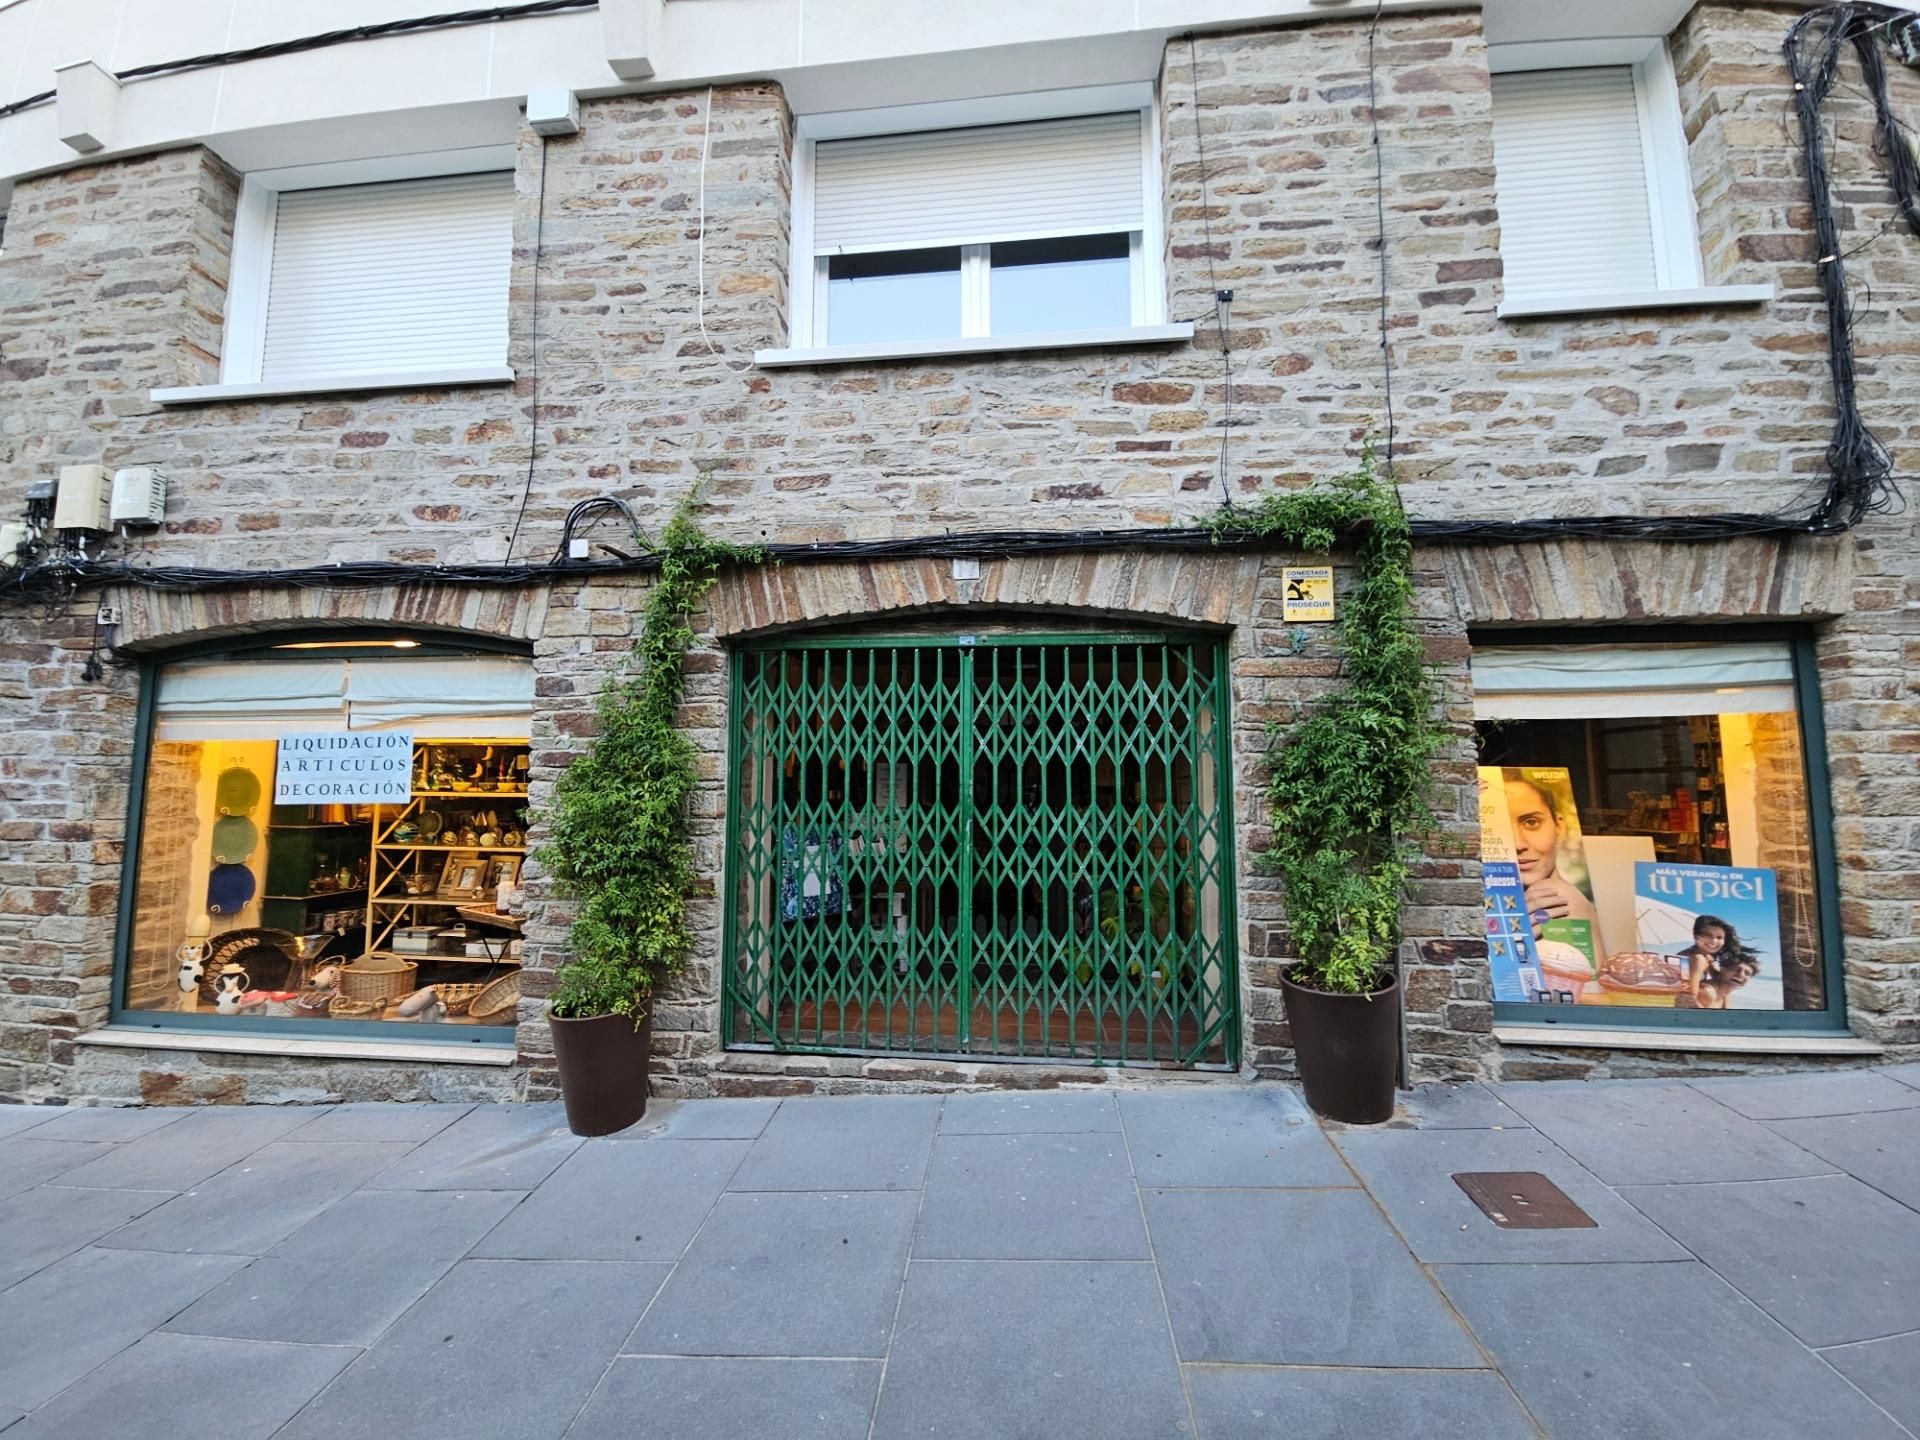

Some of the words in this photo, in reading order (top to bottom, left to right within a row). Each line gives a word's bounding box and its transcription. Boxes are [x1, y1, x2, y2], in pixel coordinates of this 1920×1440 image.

[282, 733, 409, 752] LIQUIDACIÓN
[281, 758, 407, 772] ARTICULOS
[280, 780, 407, 796] DECORACIÓN
[1656, 868, 1678, 876] MÁS
[1680, 870, 1720, 879] VERANO
[1648, 872, 1684, 895] tu
[1694, 876, 1764, 903] piel
